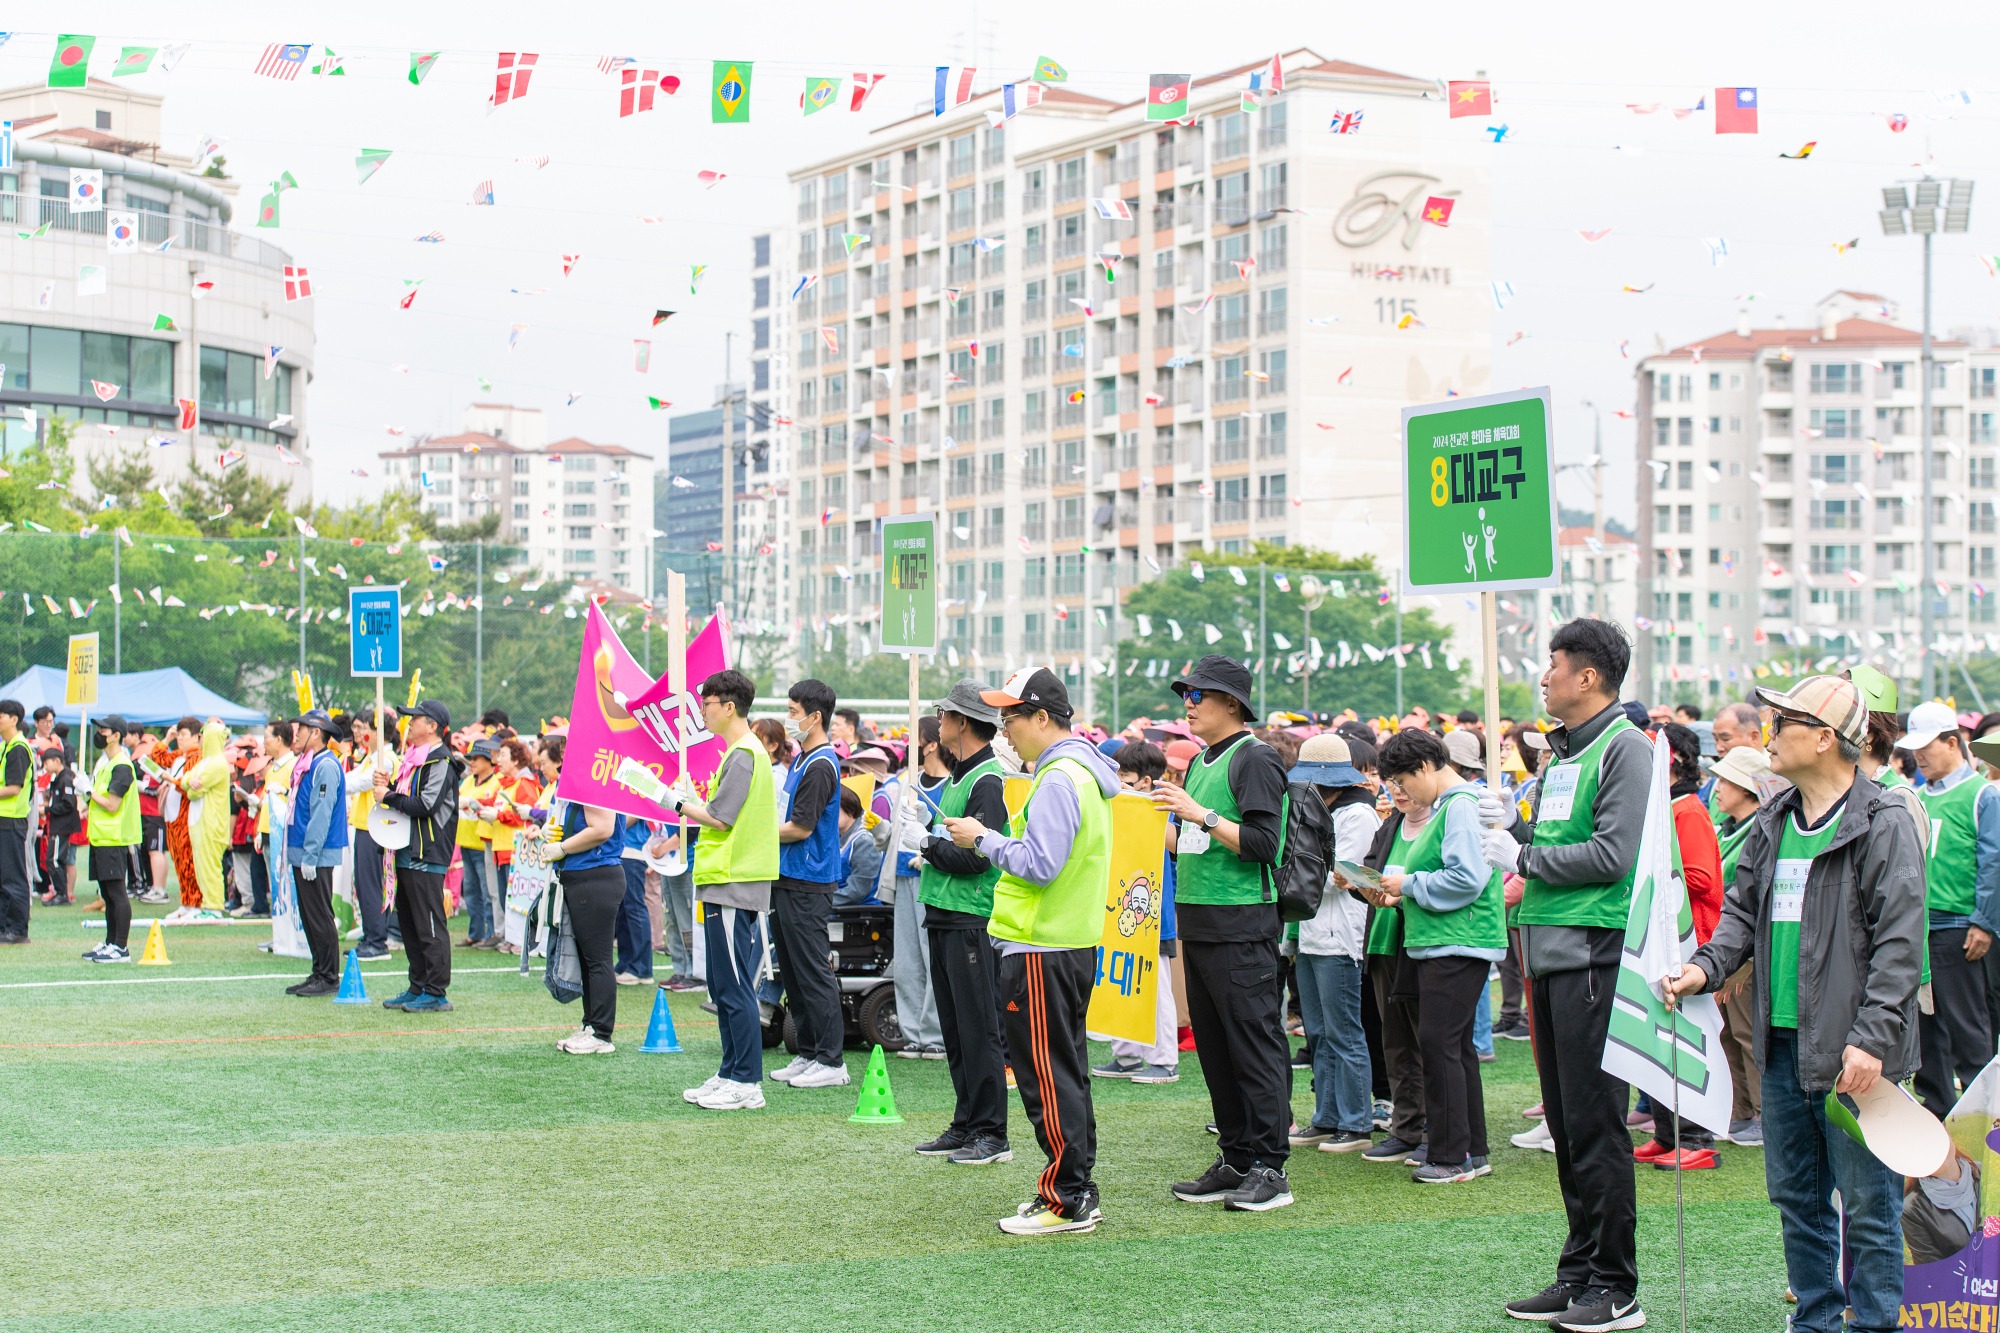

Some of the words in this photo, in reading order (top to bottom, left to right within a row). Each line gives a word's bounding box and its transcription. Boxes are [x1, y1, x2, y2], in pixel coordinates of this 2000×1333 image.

[1351, 261, 1451, 285] HILLSTATE
[1432, 435, 1448, 449] 2024
[1449, 431, 1469, 448] 전교인
[1471, 428, 1492, 445] 한마음
[1493, 424, 1520, 442] 체육대회
[1430, 446, 1526, 507] 8대교구
[891, 553, 928, 590] 4대교구
[360, 611, 392, 637] 6대교구
